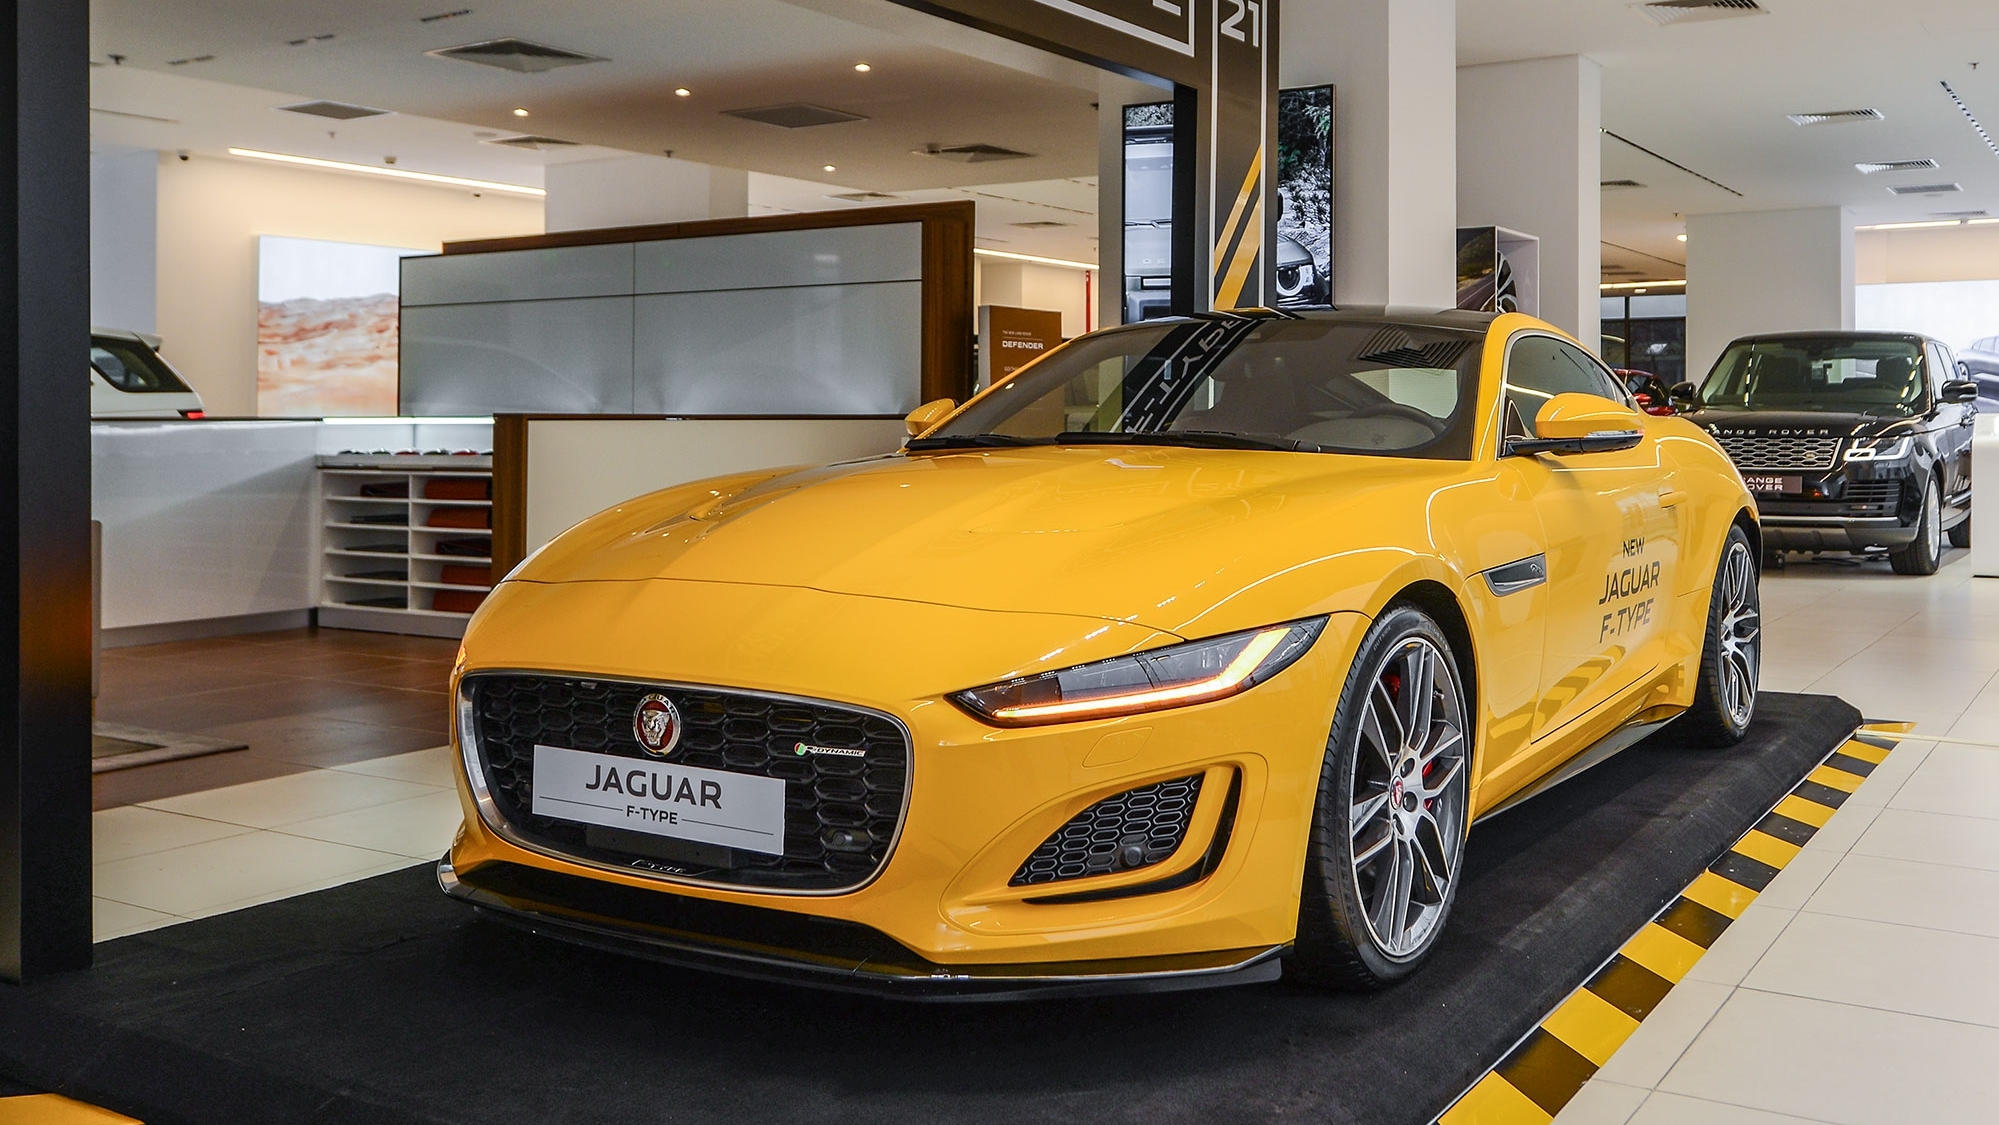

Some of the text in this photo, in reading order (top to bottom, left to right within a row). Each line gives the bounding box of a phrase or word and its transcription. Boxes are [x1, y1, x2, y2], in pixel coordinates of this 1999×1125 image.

[1220, 0, 1259, 47] 21
[1002, 340, 1044, 350] DEFENDER
[1622, 537, 1645, 558] NEW
[1599, 561, 1660, 605] JAGUAR
[1600, 598, 1654, 643] F-TYPE
[585, 764, 722, 809] JAGUAR
[626, 805, 678, 825] F-TYPE
